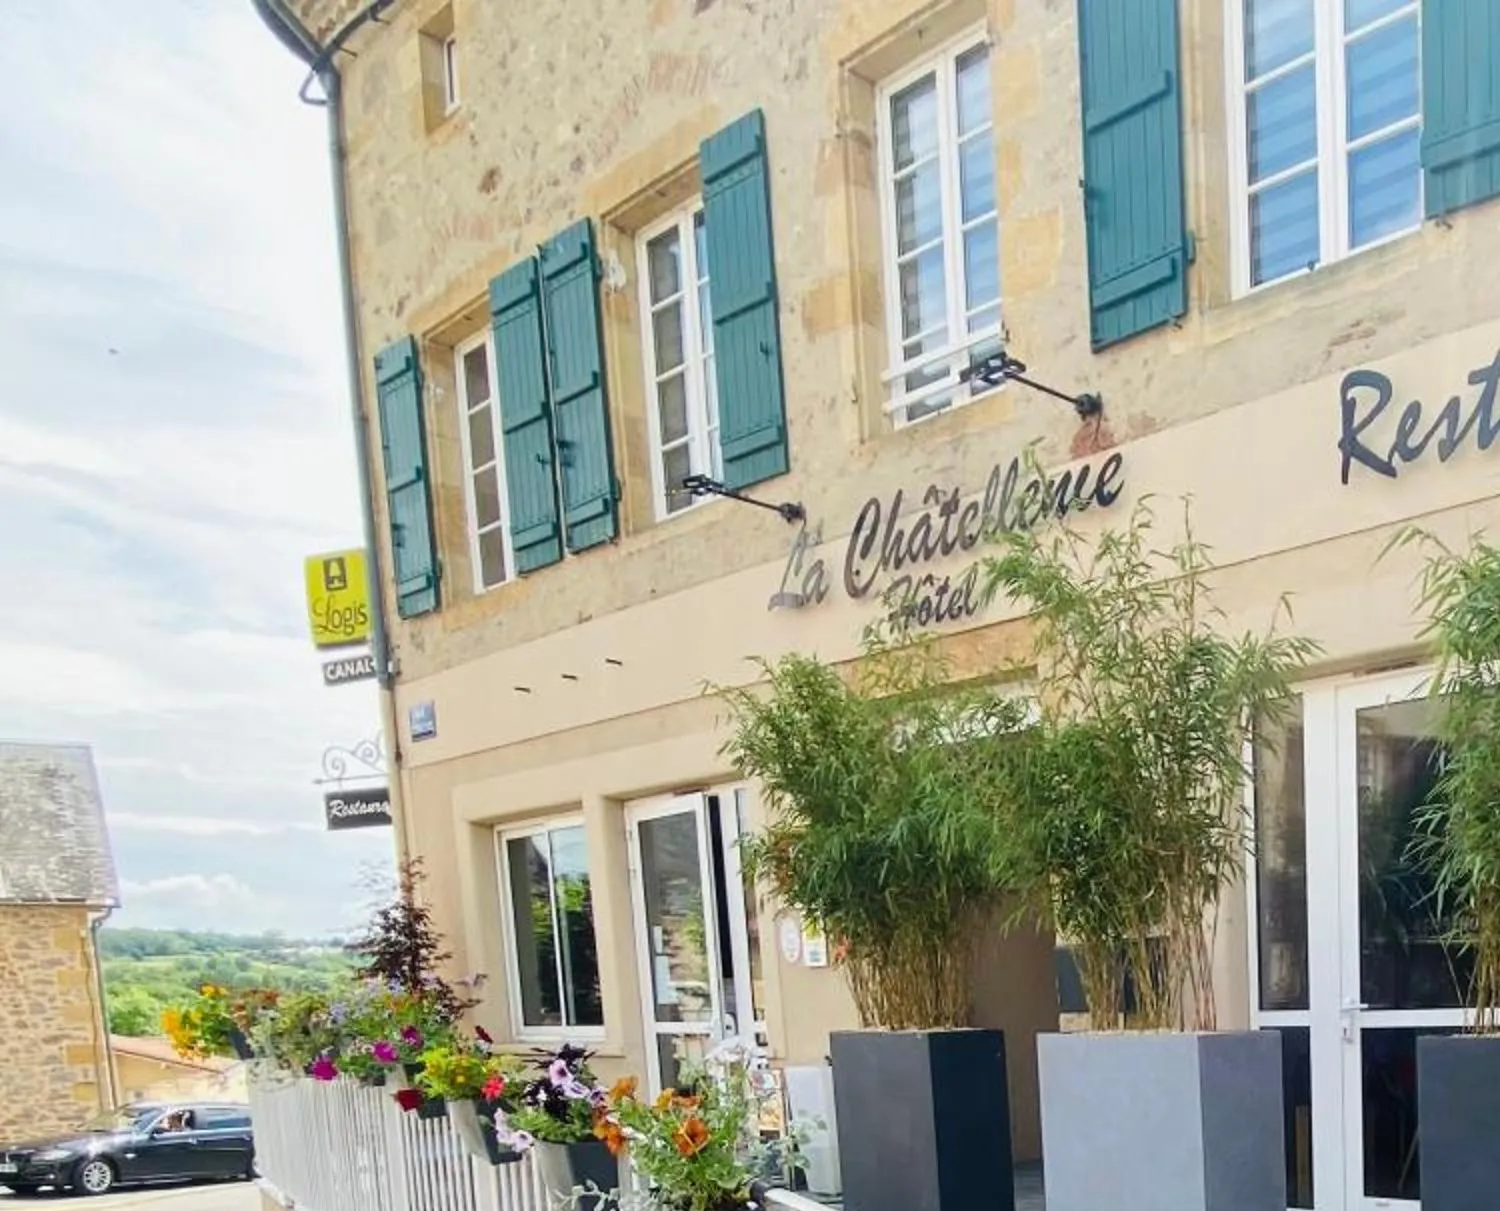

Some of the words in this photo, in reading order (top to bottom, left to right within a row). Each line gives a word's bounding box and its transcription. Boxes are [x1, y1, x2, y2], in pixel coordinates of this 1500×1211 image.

[767, 527, 830, 611] La
[887, 561, 979, 633] Hôtel
[312, 594, 368, 636] Logis
[328, 798, 391, 819] Restaura
